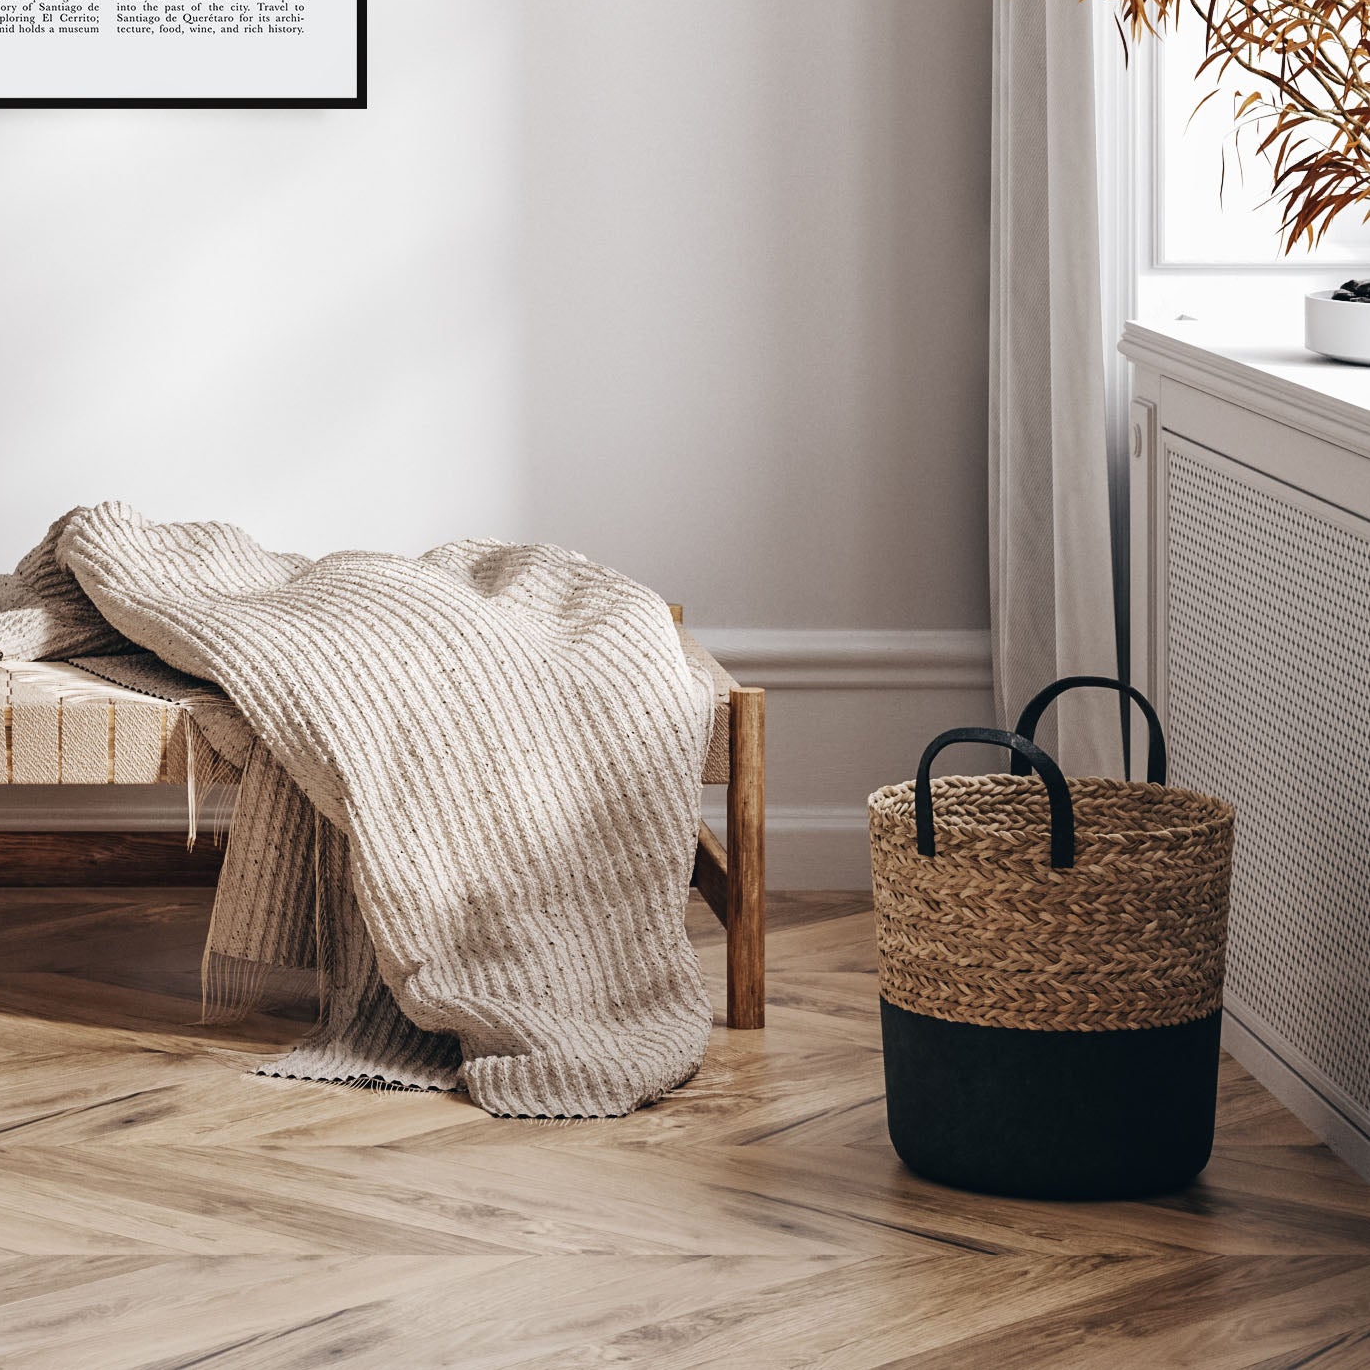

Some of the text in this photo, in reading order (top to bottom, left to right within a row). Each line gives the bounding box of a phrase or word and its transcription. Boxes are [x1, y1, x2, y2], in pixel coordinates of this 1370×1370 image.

[22, 3, 33, 11] of
[39, 3, 83, 14] Santiago
[87, 3, 99, 11] de
[19, 24, 45, 33] holds
[117, 24, 304, 36] tecture, food, wine, and rich history.
